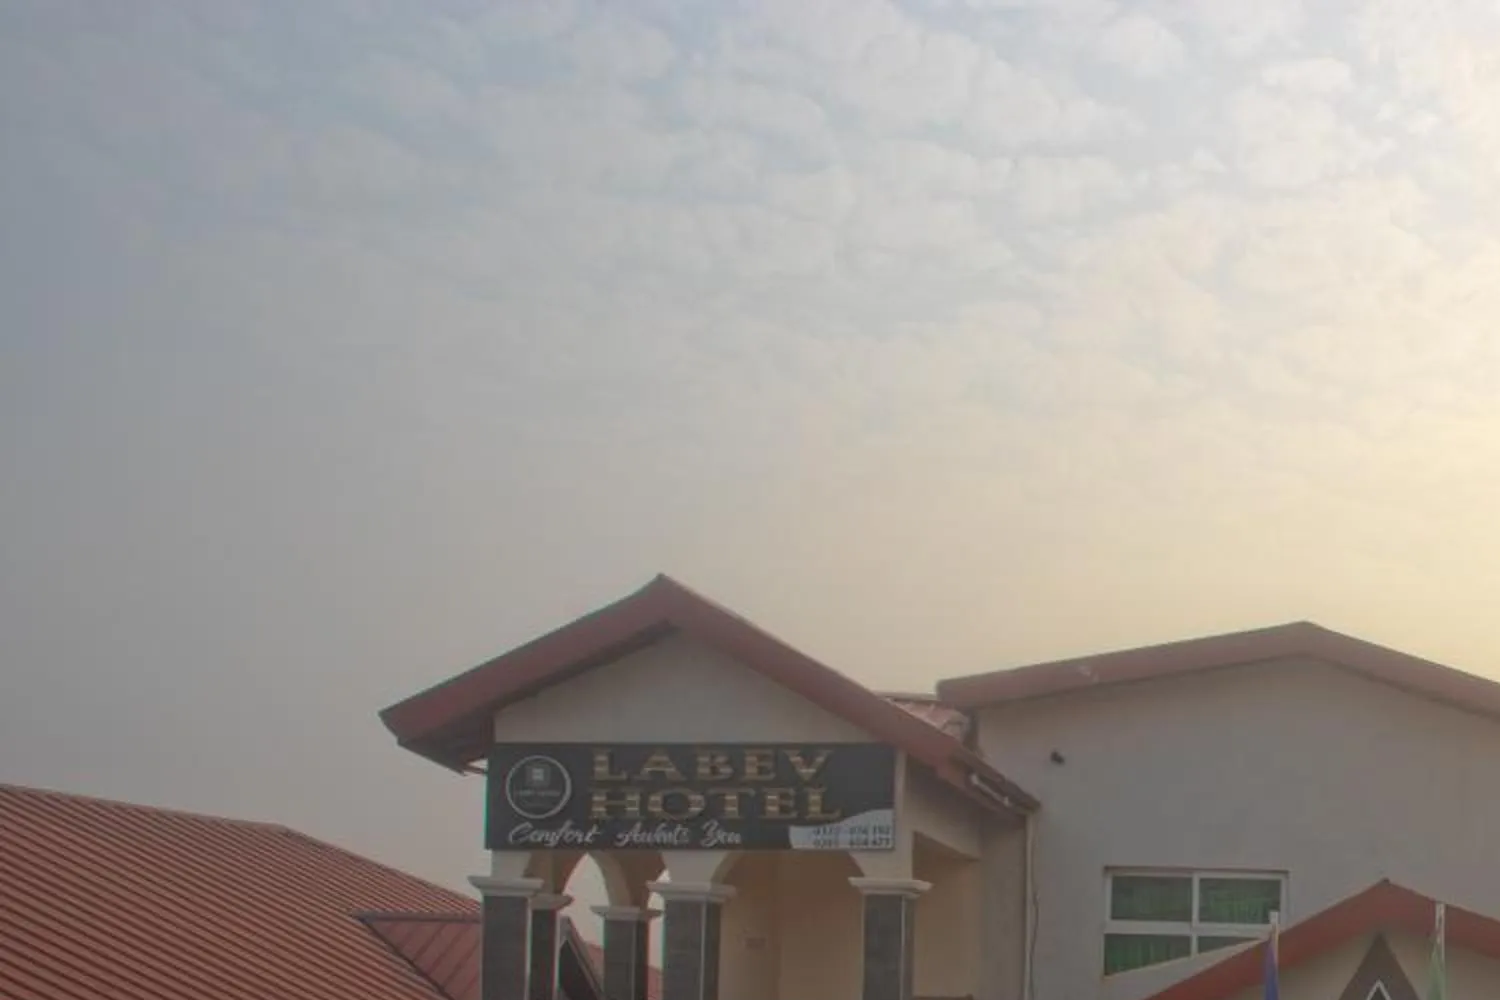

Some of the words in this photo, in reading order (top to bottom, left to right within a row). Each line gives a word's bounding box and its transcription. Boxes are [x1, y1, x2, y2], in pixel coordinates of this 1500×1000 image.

[588, 787, 842, 821] HOTEL
[508, 821, 600, 847] Comfort
[615, 822, 689, 847] Awaits
[700, 819, 742, 847] You
